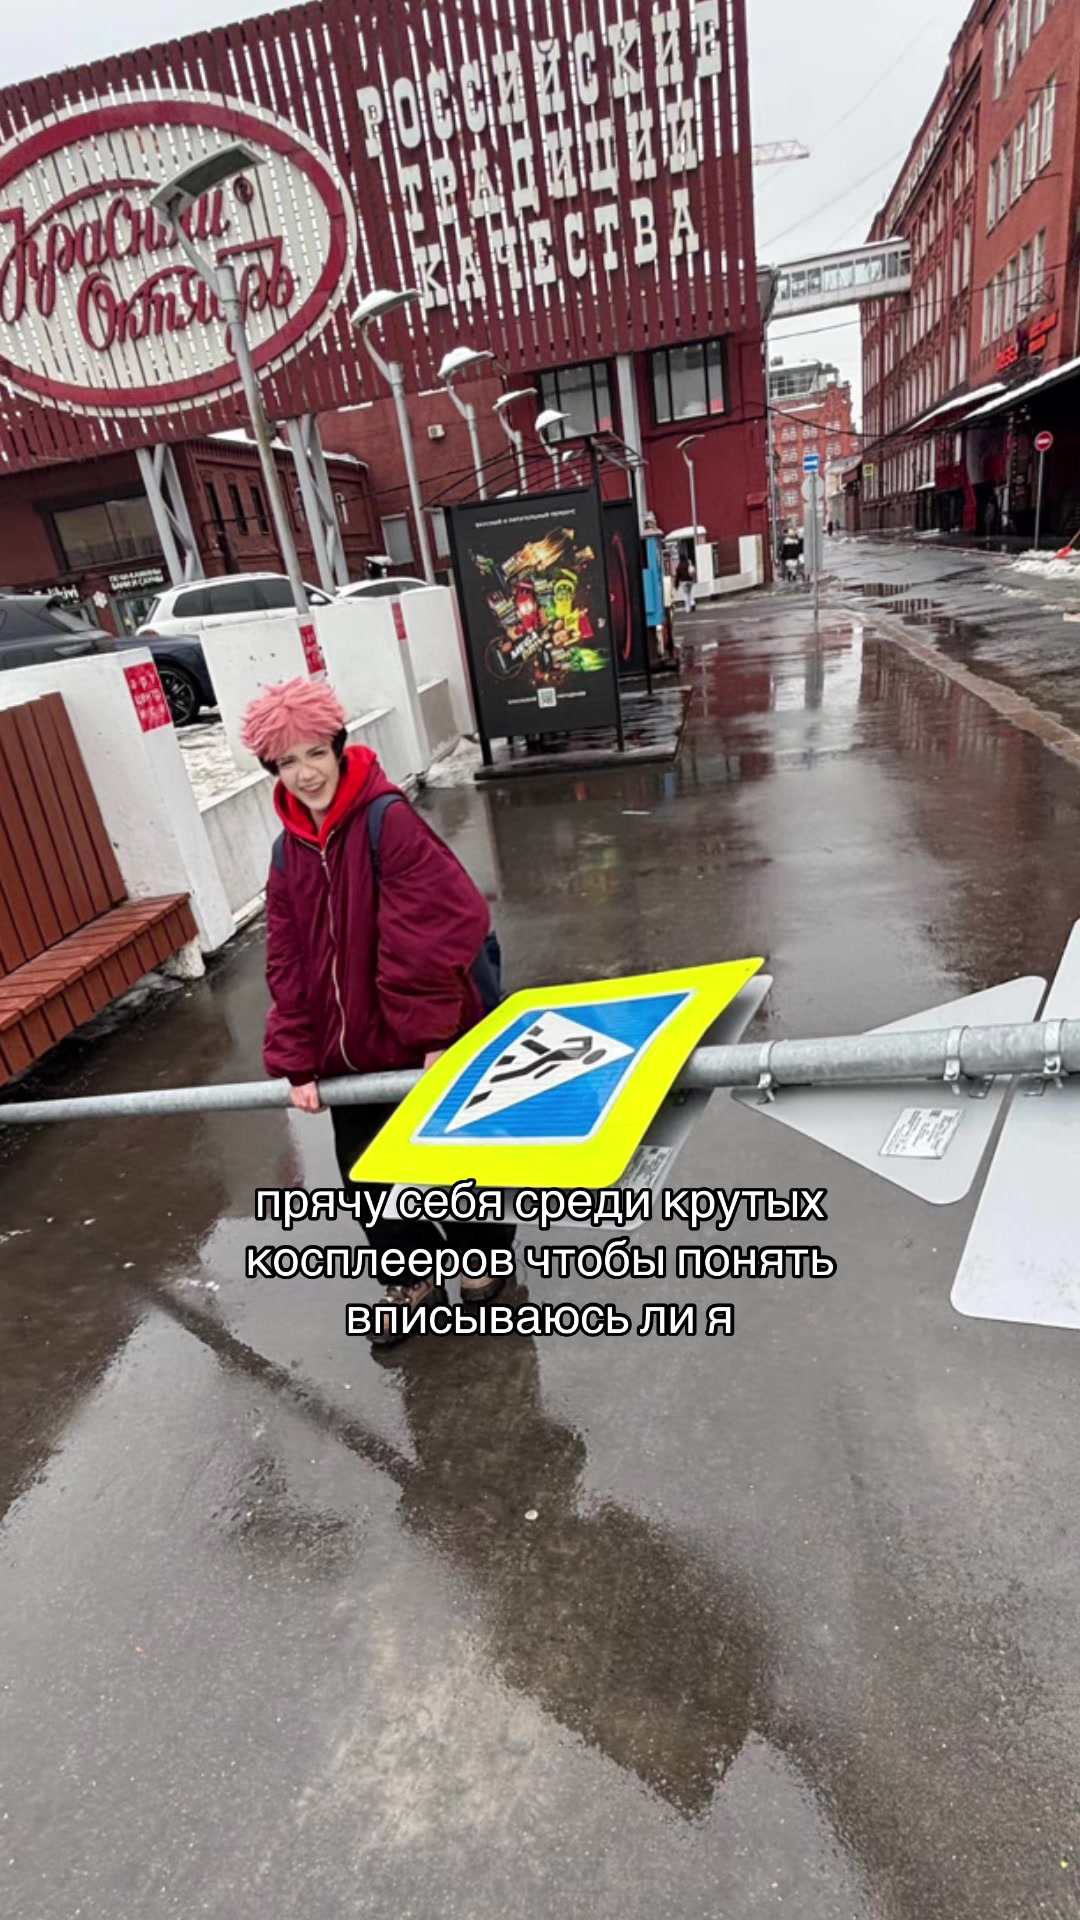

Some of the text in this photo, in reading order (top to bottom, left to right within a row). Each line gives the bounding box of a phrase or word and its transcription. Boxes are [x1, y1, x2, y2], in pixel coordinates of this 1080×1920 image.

[356, 1, 722, 158] РОССИЙСКИЕ
[401, 98, 698, 232] ТРАДИЦИИ
[414, 188, 700, 309] КАЧЕСТВА
